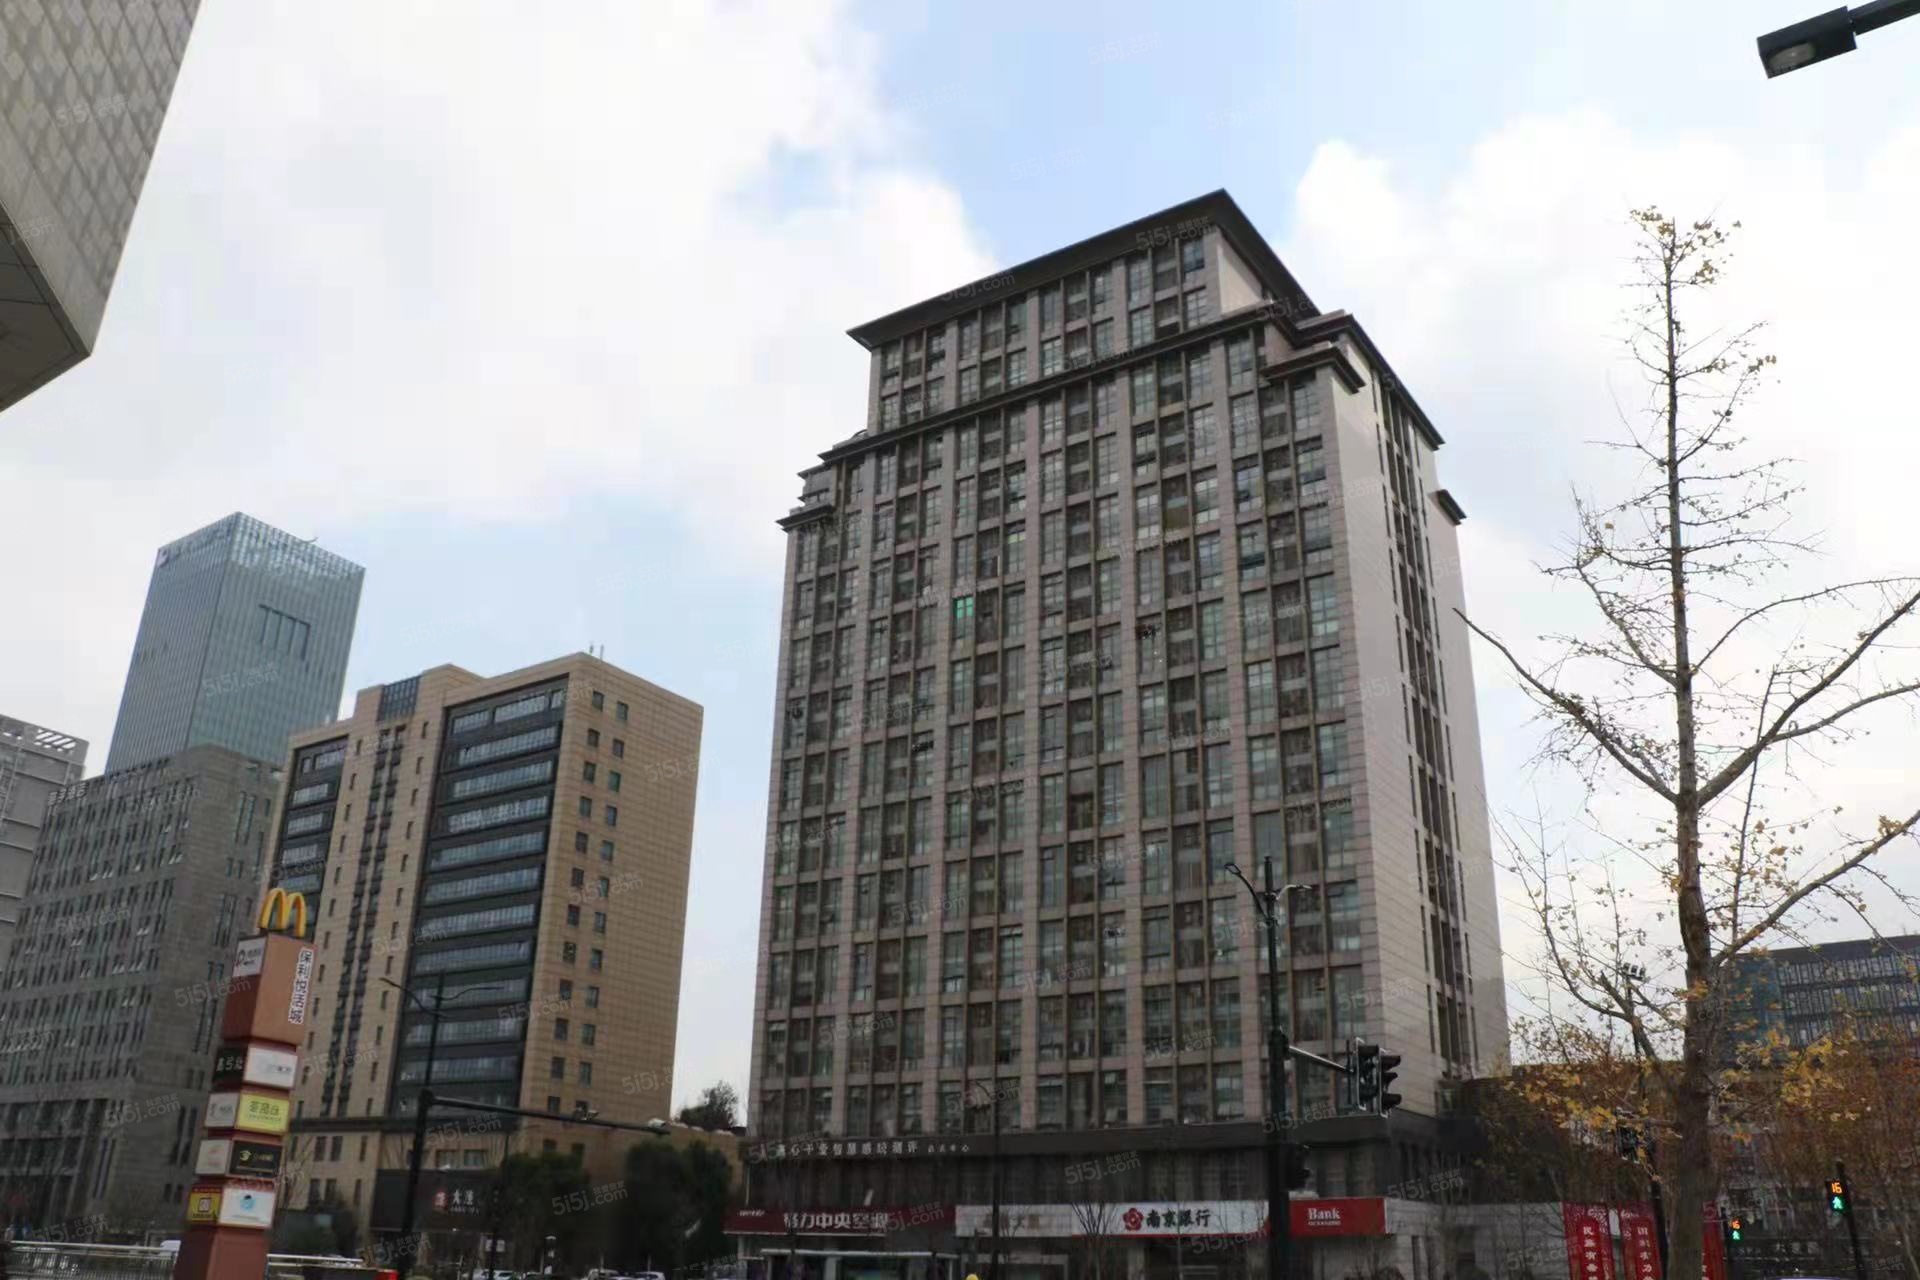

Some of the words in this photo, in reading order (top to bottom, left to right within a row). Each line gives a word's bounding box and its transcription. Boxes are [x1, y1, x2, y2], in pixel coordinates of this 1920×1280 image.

[1831, 1182, 1842, 1194] 16
[1146, 1208, 1210, 1227] 南京银行
[1307, 1207, 1340, 1220] Bank
